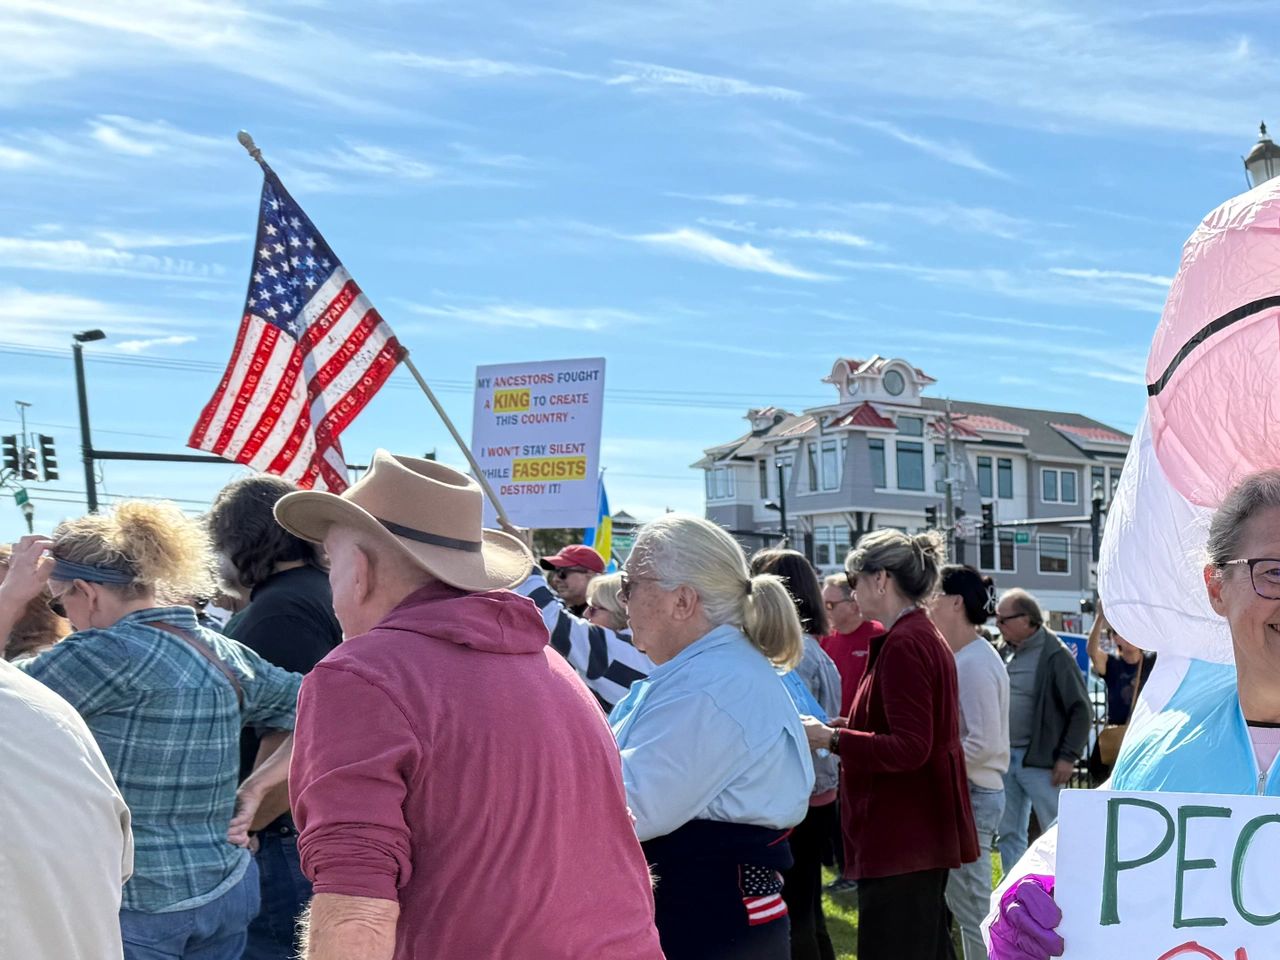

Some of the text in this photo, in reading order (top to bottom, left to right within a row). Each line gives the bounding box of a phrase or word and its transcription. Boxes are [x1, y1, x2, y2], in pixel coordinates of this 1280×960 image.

[320, 289, 352, 329] STANDS
[238, 376, 258, 405] FLAG
[253, 357, 266, 372] OF
[262, 328, 277, 353] THE
[478, 370, 599, 388] MY ANCESTORS FOUGHT
[484, 392, 589, 409] A KING TO CREATE
[241, 417, 273, 458] UITED
[271, 371, 297, 414] STATES
[496, 414, 518, 426] THIS
[521, 412, 568, 424] COUNTRY
[487, 446, 520, 457] WON'T
[522, 445, 547, 456] STAY
[549, 443, 586, 455] SILENT
[512, 459, 586, 478] FASCISTS
[500, 484, 561, 495] DESTROY IT!
